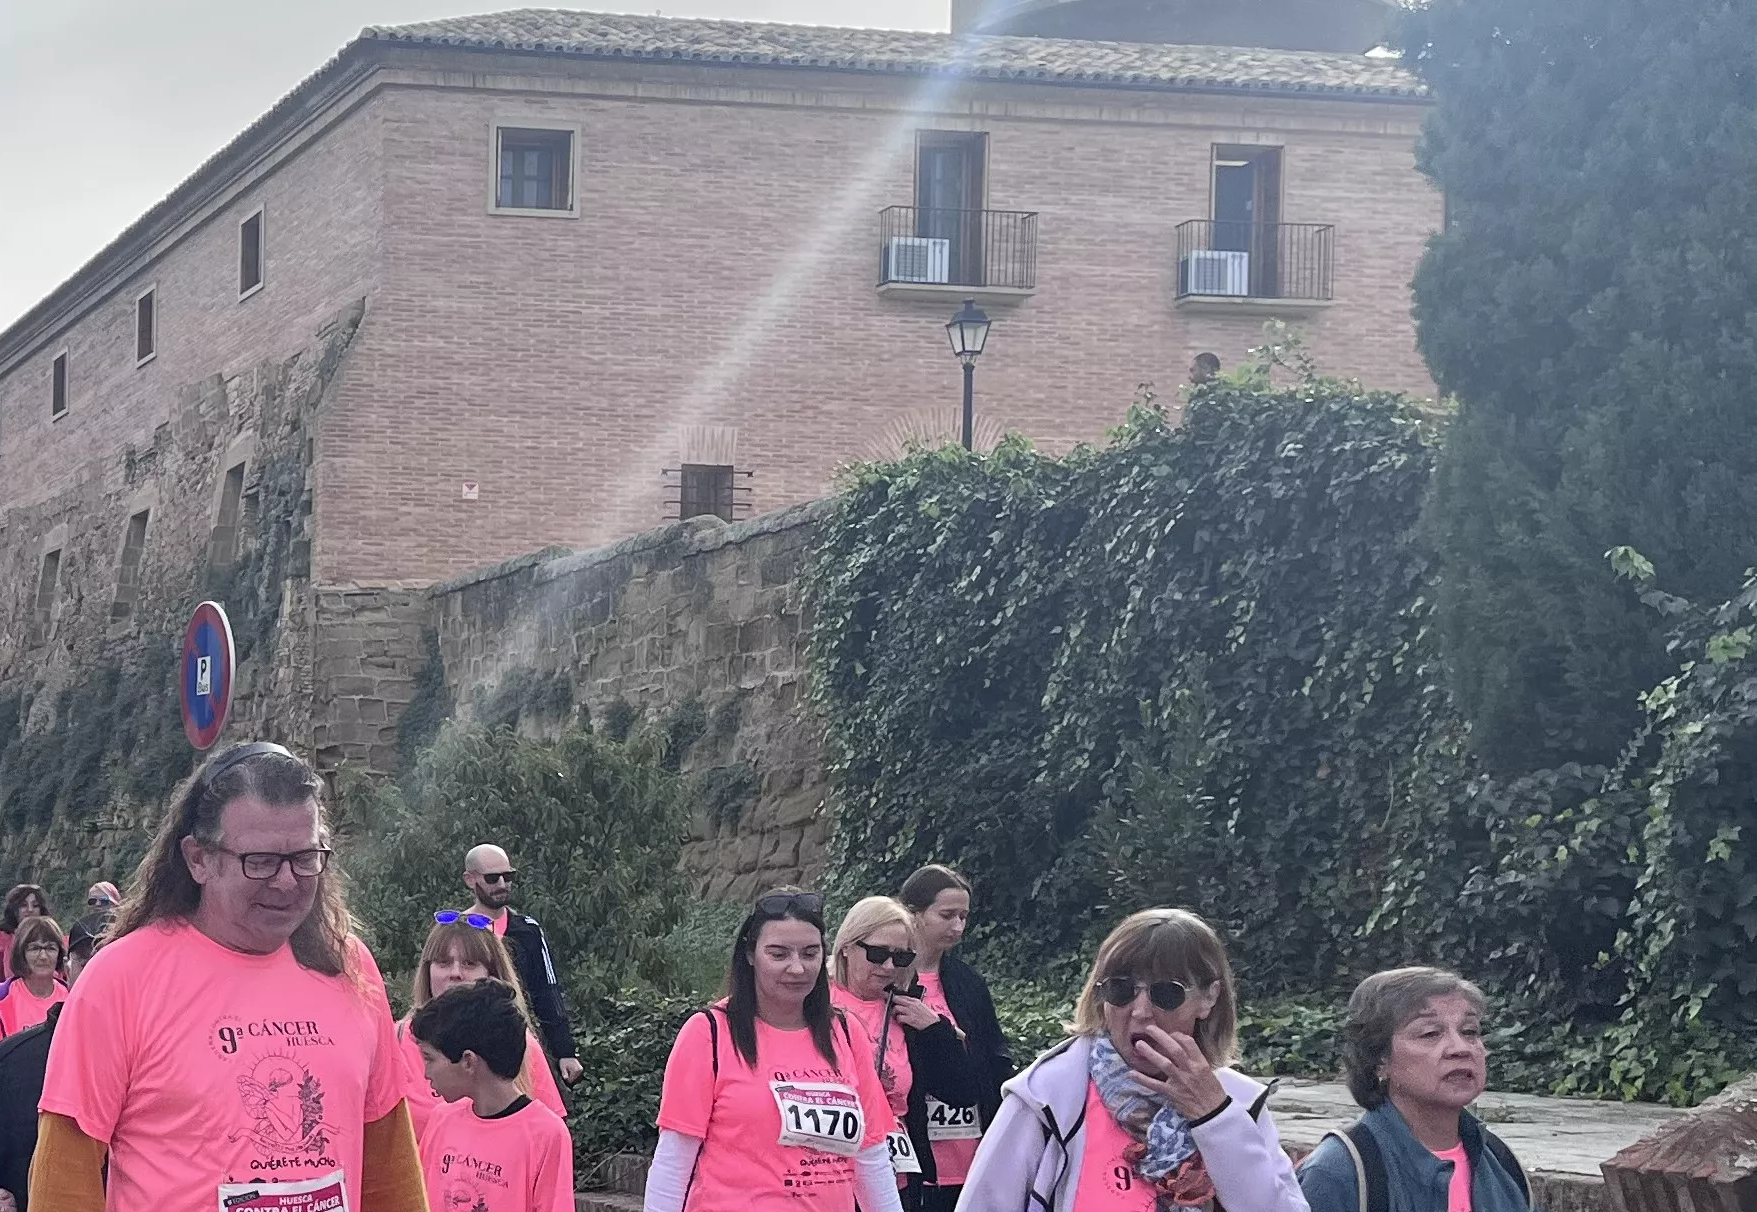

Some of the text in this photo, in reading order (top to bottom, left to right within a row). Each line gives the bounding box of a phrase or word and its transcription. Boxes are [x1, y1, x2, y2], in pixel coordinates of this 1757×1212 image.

[201, 659, 207, 681] P
[248, 1018, 319, 1037] CÁNCER
[286, 1036, 335, 1047] HUESCA
[787, 1104, 859, 1139] 1170
[304, 1156, 336, 1169] MUCHO
[279, 1194, 313, 1205] HUESCA
